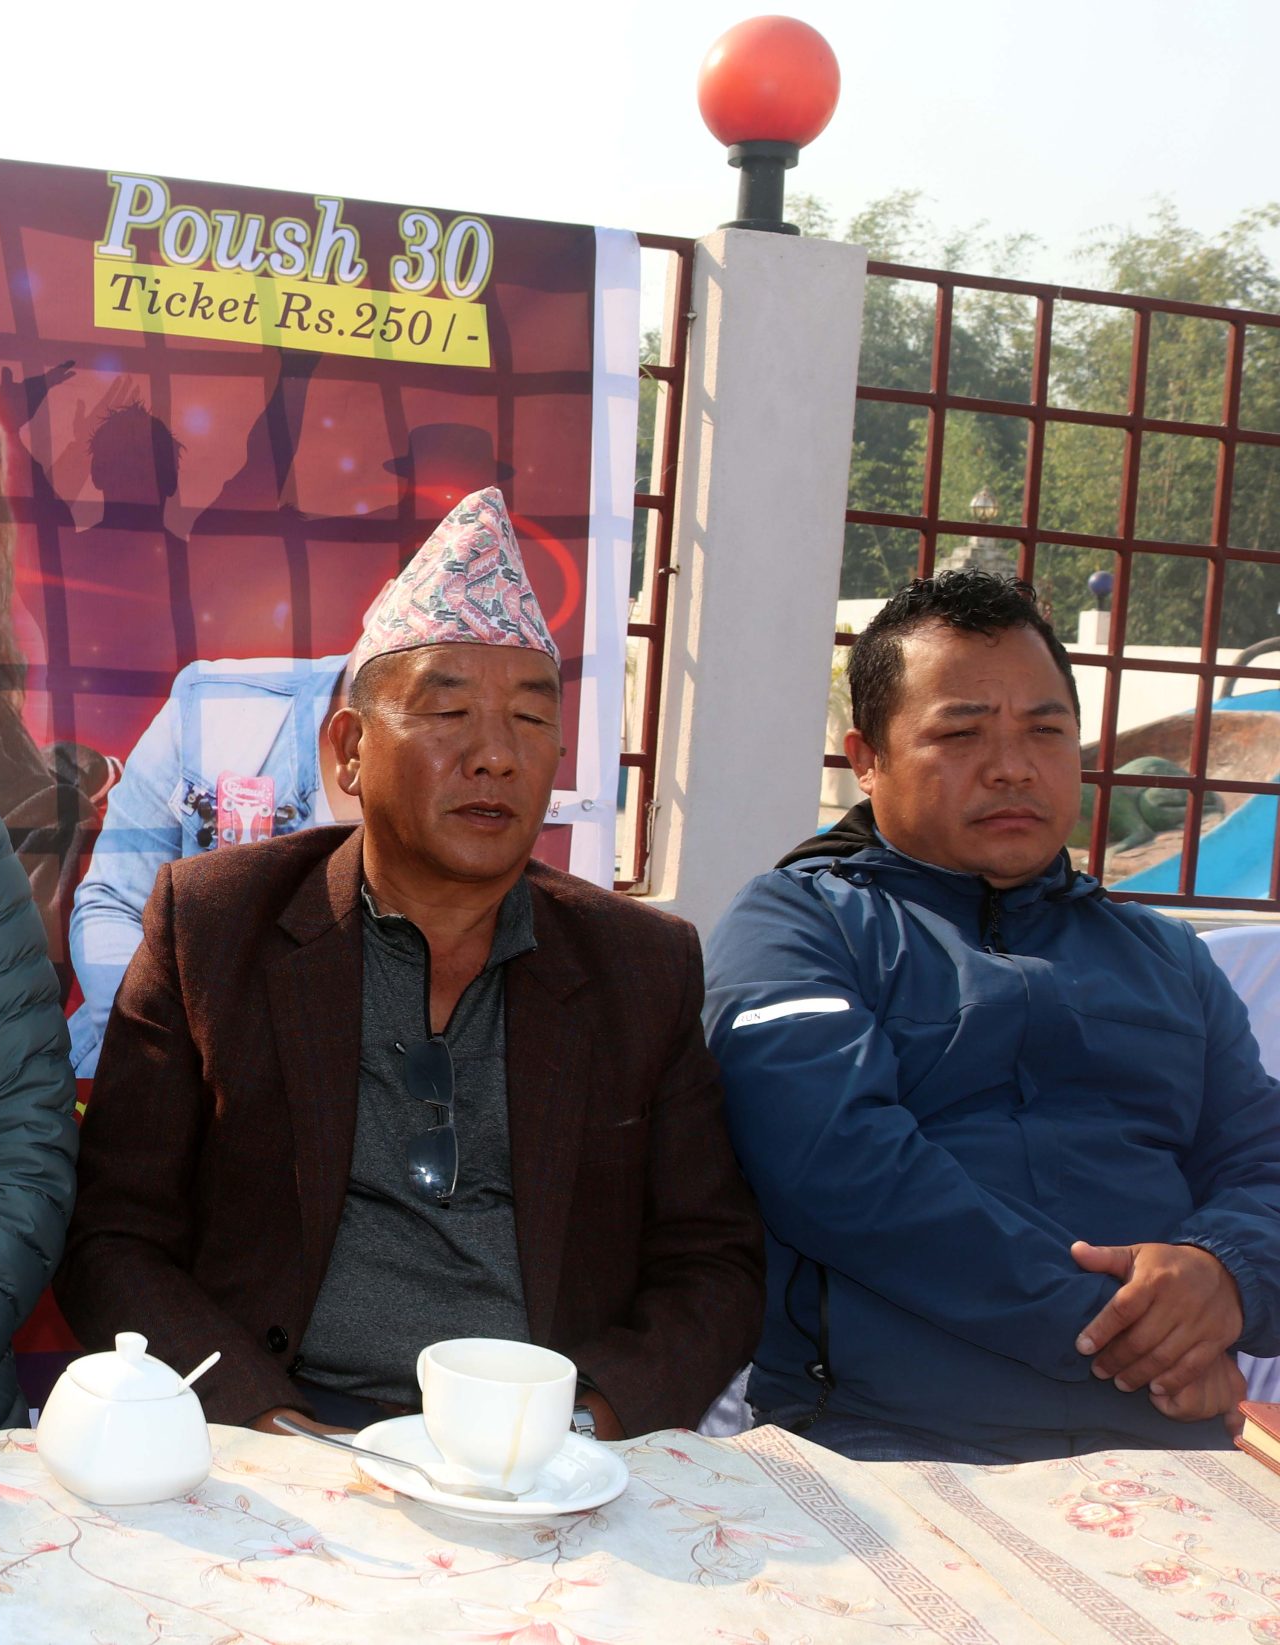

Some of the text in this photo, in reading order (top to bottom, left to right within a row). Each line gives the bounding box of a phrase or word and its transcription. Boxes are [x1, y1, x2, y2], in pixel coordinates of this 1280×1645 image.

[94, 171, 494, 302] Poush 30
[109, 273, 260, 325] Ticket
